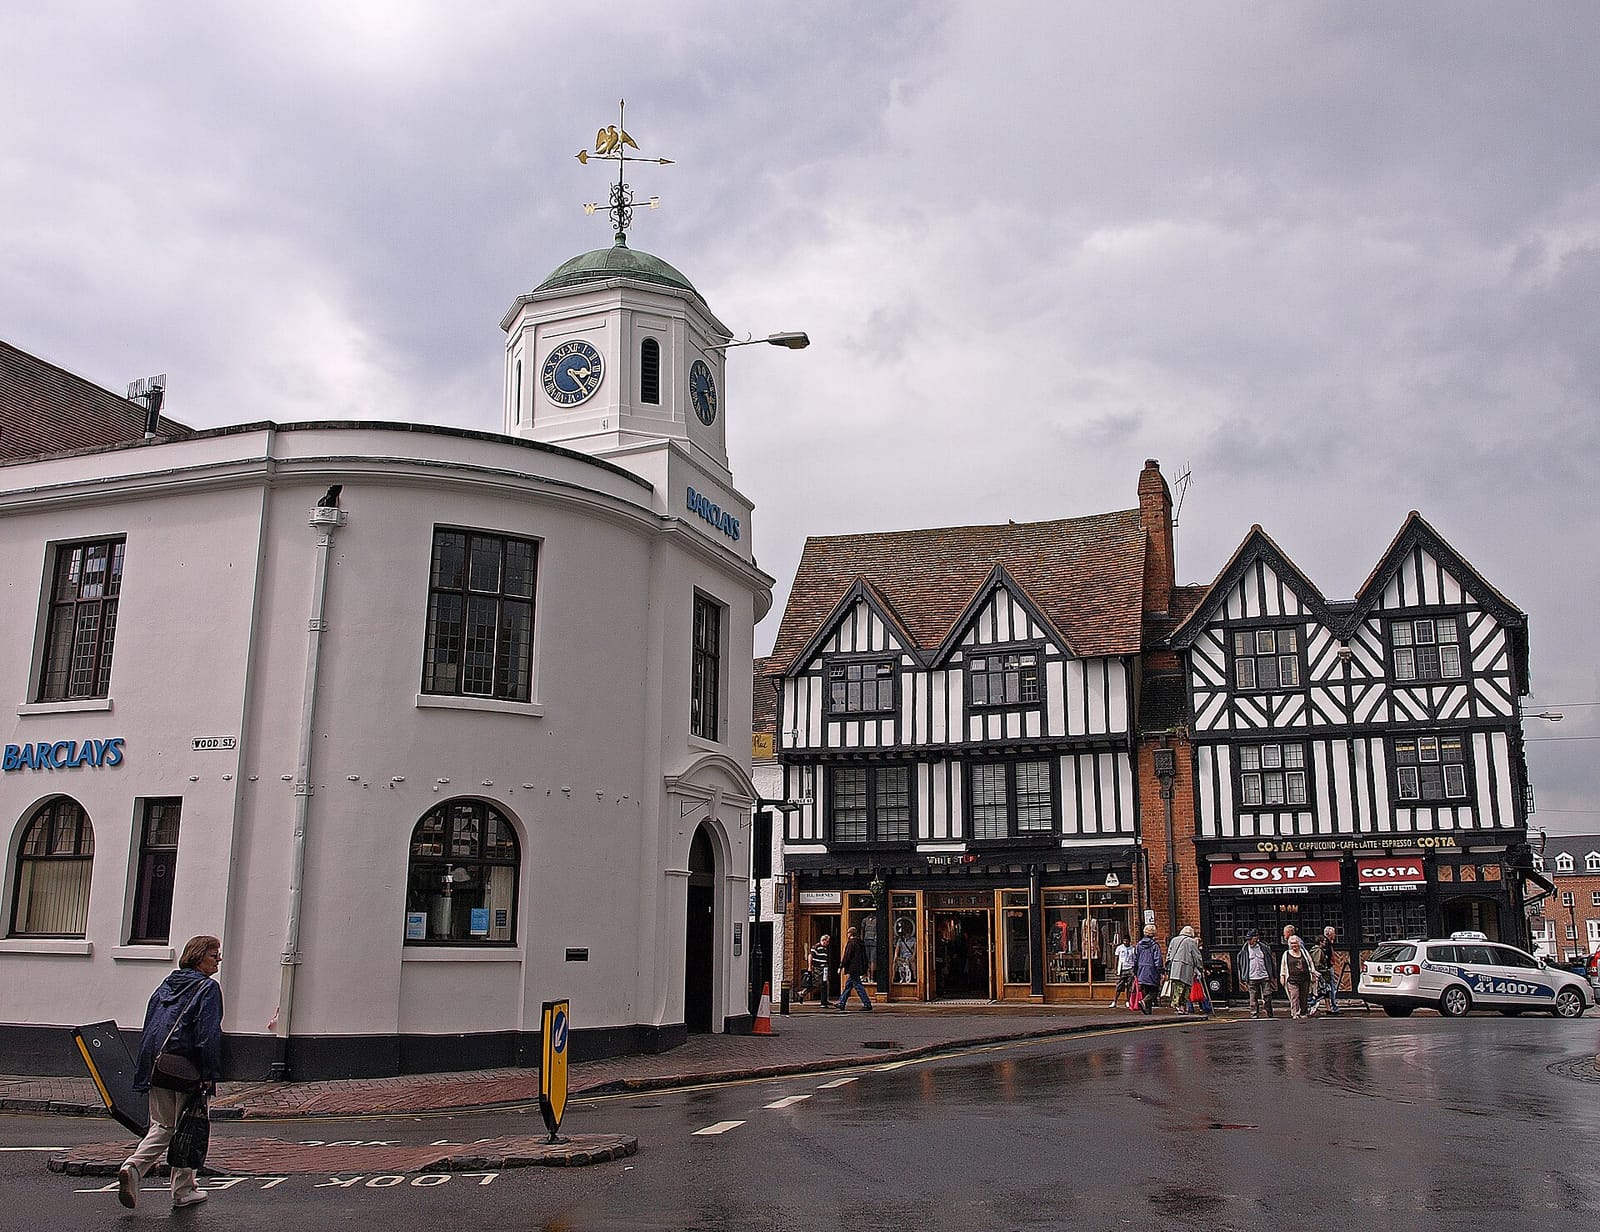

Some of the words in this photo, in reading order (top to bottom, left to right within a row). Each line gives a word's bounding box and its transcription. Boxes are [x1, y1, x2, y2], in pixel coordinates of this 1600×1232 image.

[686, 486, 740, 541] BARCLAYS
[194, 739, 219, 748] WOOD
[1, 737, 125, 771] BARCLAYS
[1257, 841, 1294, 852] COSTA
[1299, 841, 1336, 851] CAPPUCCINO
[1360, 840, 1378, 849] LATTE
[1381, 839, 1412, 848] ESPRESSO
[1417, 837, 1456, 848] COSTA
[926, 855, 952, 865] WHITE
[1233, 865, 1316, 881] COSTA
[1361, 867, 1420, 877] COSTA
[1254, 887, 1274, 895] MAKE
[1282, 886, 1309, 894] BETTER
[1473, 981, 1539, 994] 414007
[314, 1173, 500, 1188] LOOK
